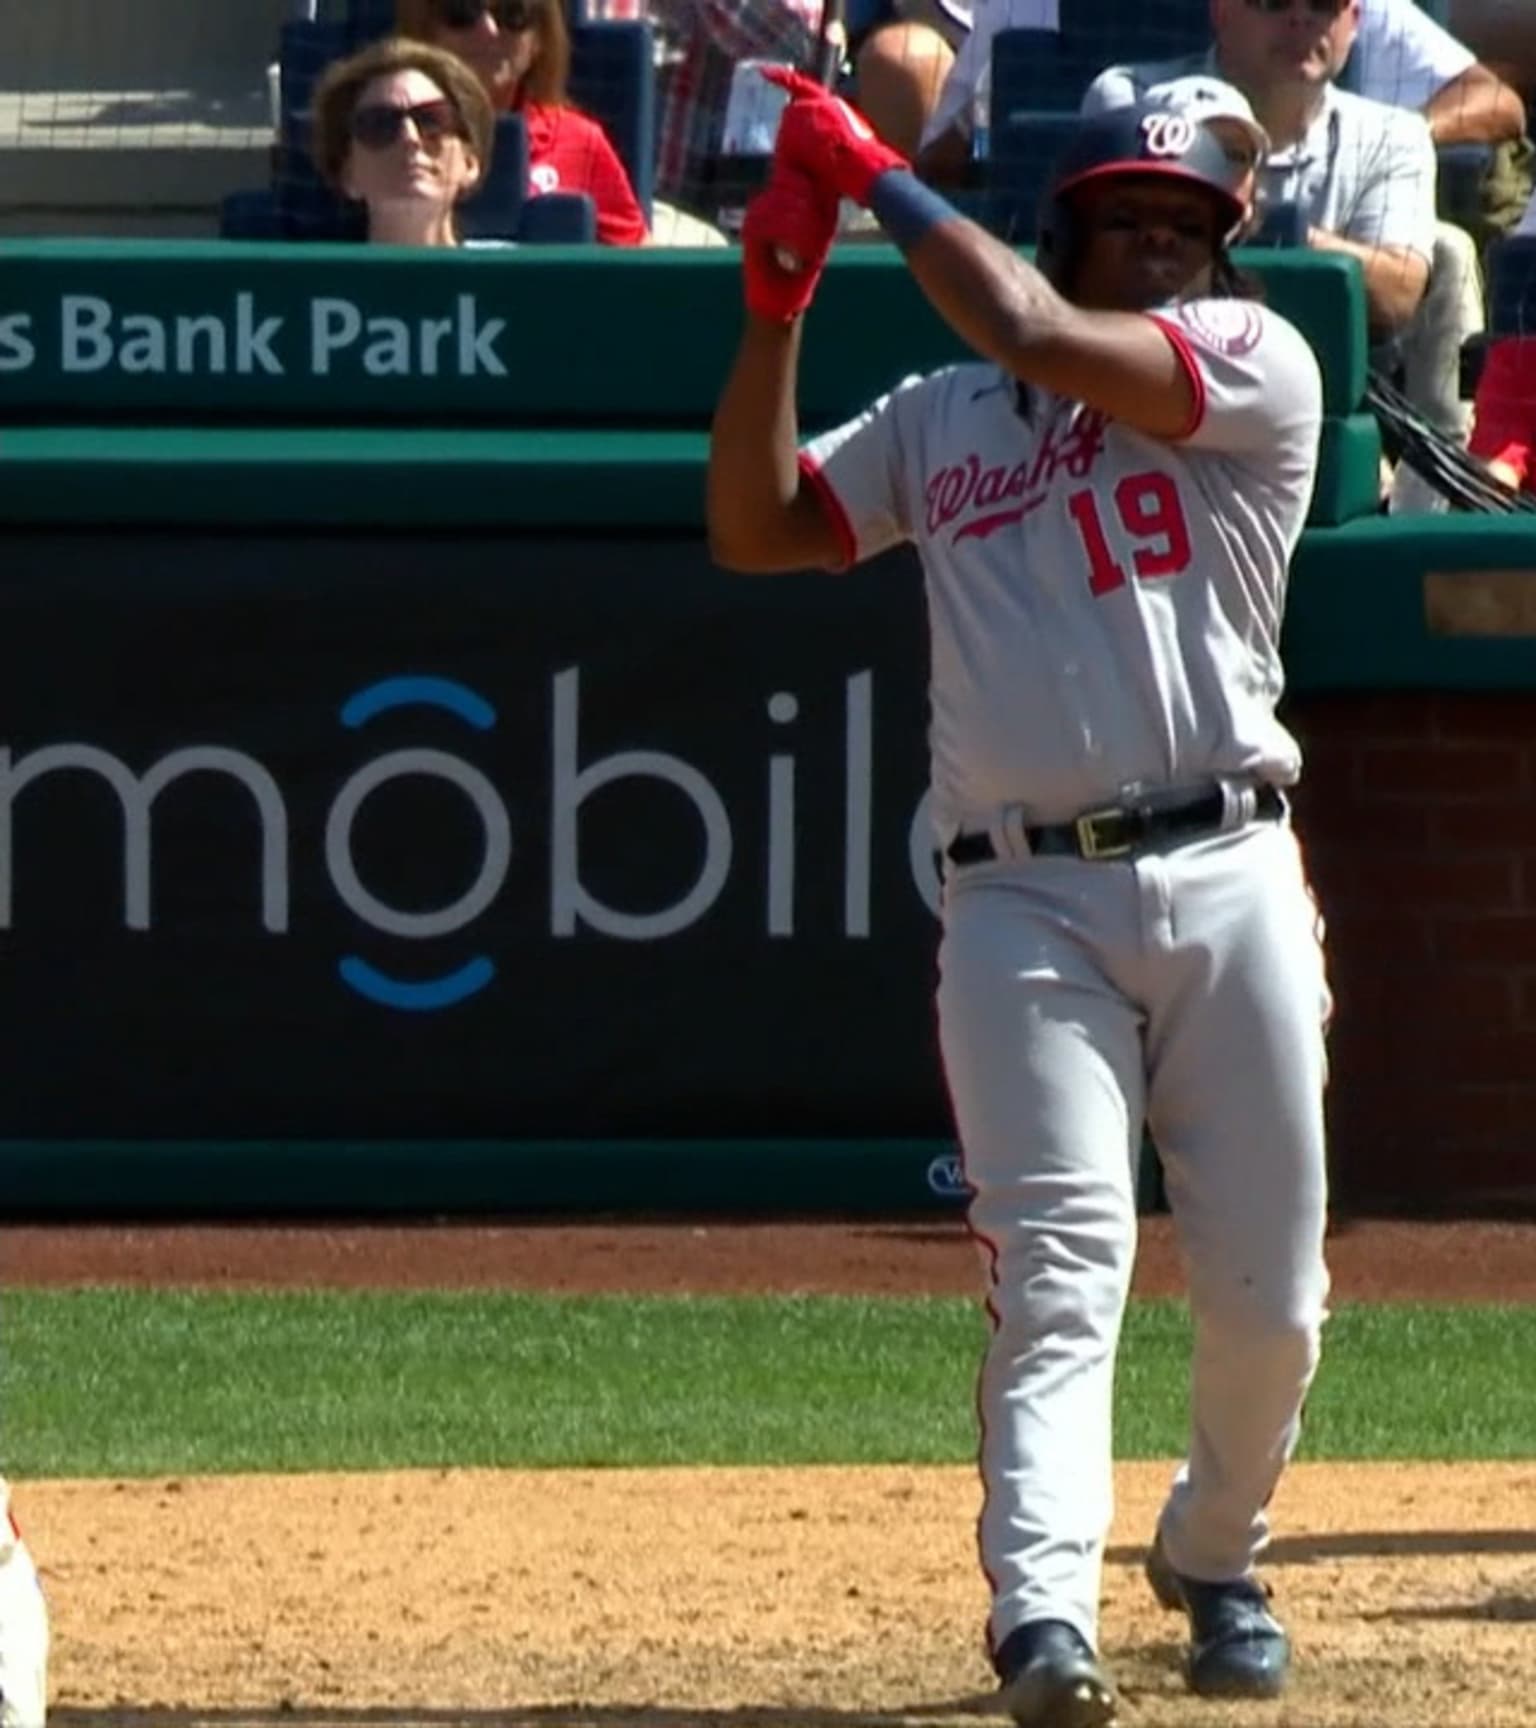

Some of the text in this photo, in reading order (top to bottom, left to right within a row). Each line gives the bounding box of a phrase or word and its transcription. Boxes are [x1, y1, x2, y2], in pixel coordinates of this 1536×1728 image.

[1142, 113, 1197, 157] W
[61, 292, 285, 374] Bank
[310, 293, 508, 377] Park
[1066, 468, 1193, 598] 19
[0, 666, 944, 940] mobil
